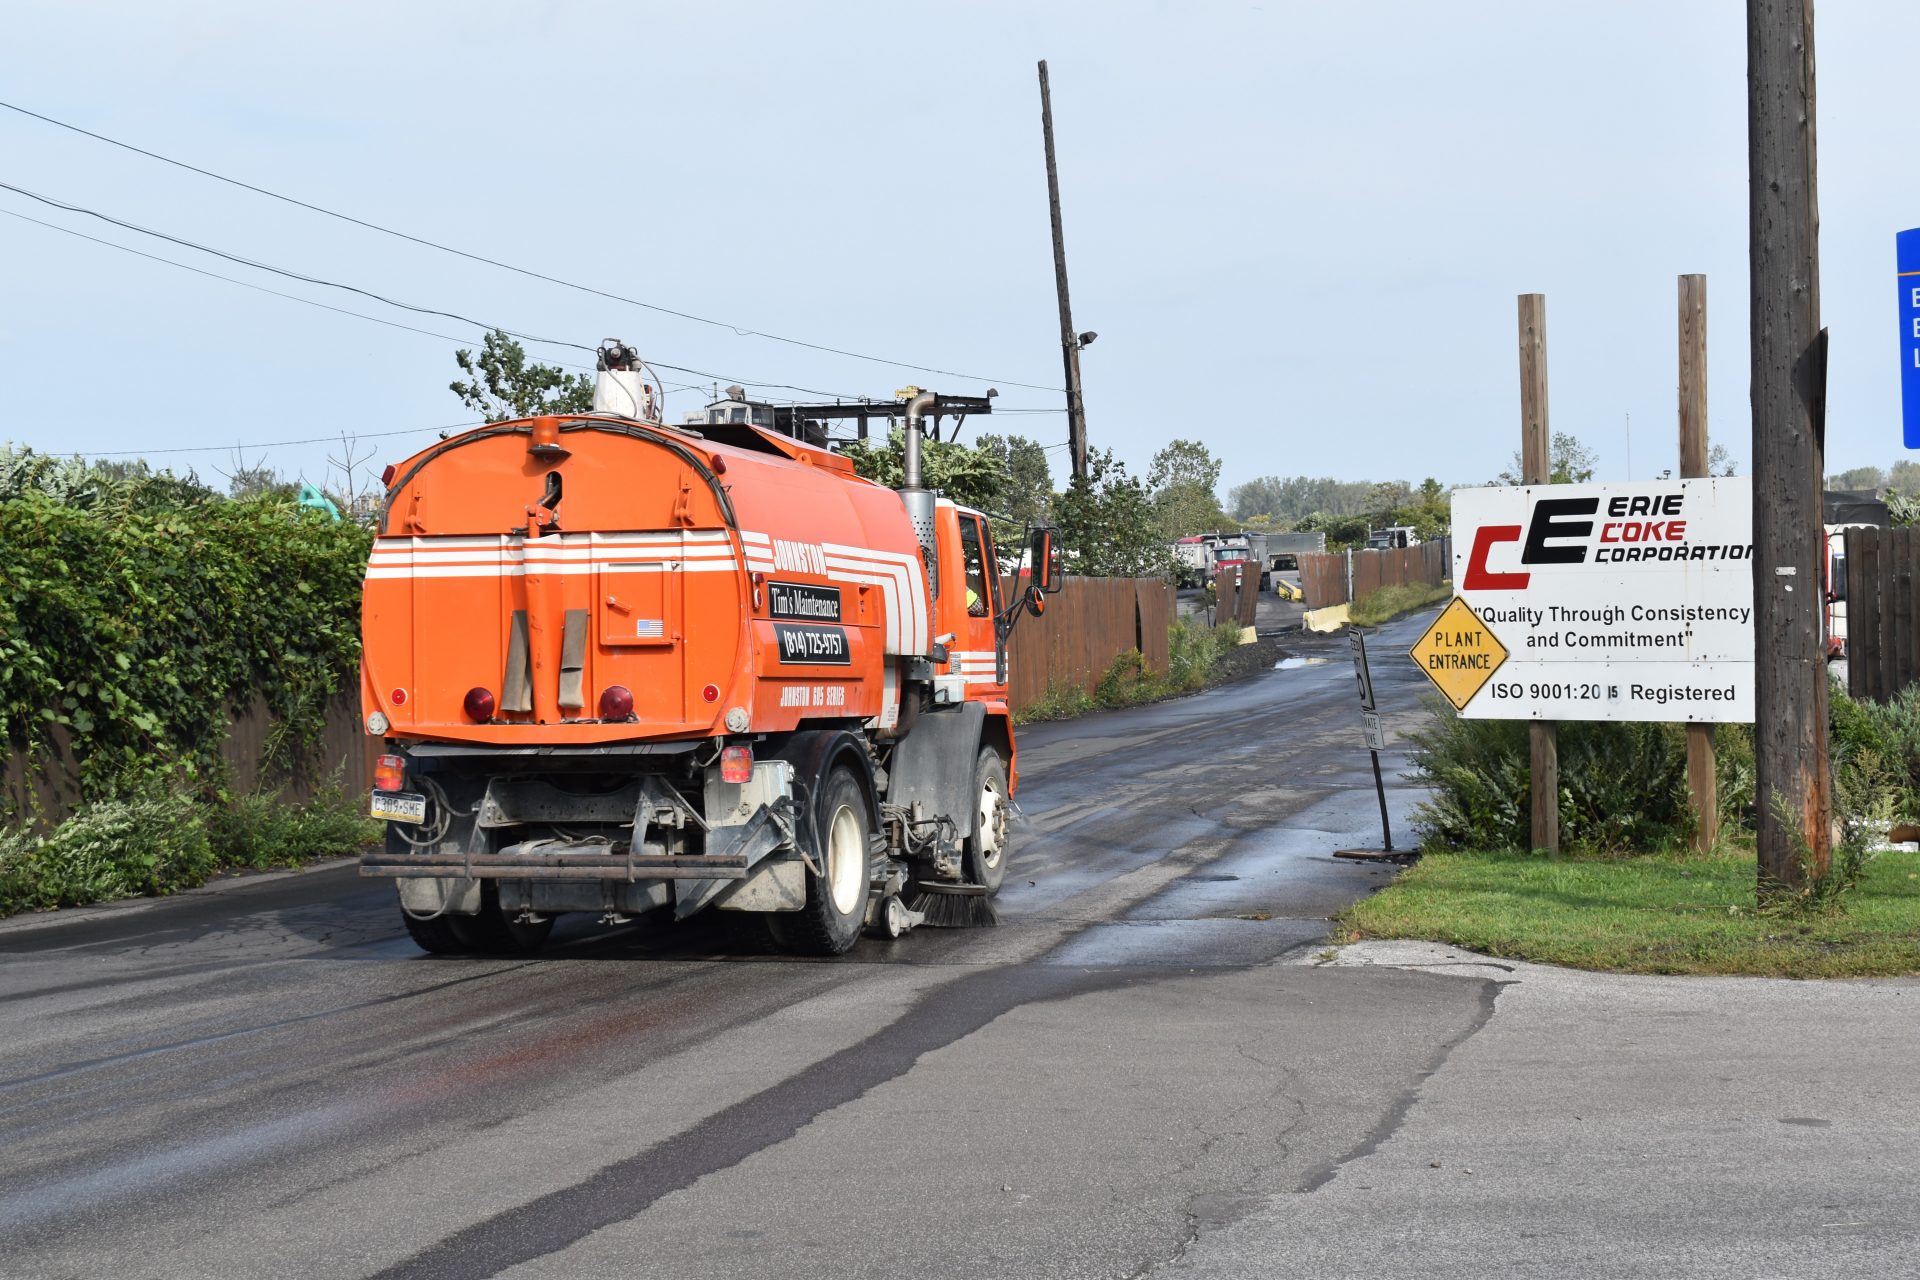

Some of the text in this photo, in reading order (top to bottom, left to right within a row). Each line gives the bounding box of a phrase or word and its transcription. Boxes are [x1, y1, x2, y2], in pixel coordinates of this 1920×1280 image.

[1608, 495, 1684, 517] ERIE
[1600, 521, 1687, 542] COKE
[773, 539, 827, 575] JOHNSTON
[772, 588, 793, 613] Tim's
[795, 590, 838, 617] Maintenance
[1474, 605, 1750, 626] "Quality Through Consistency
[784, 629, 842, 658] (814) 725-9757
[1435, 632, 1482, 647] PLANT
[1527, 631, 1693, 648] and Commitment"
[1429, 654, 1491, 670] ENTRANCE
[1492, 684, 1523, 699] ISO
[1631, 684, 1735, 704] Registered
